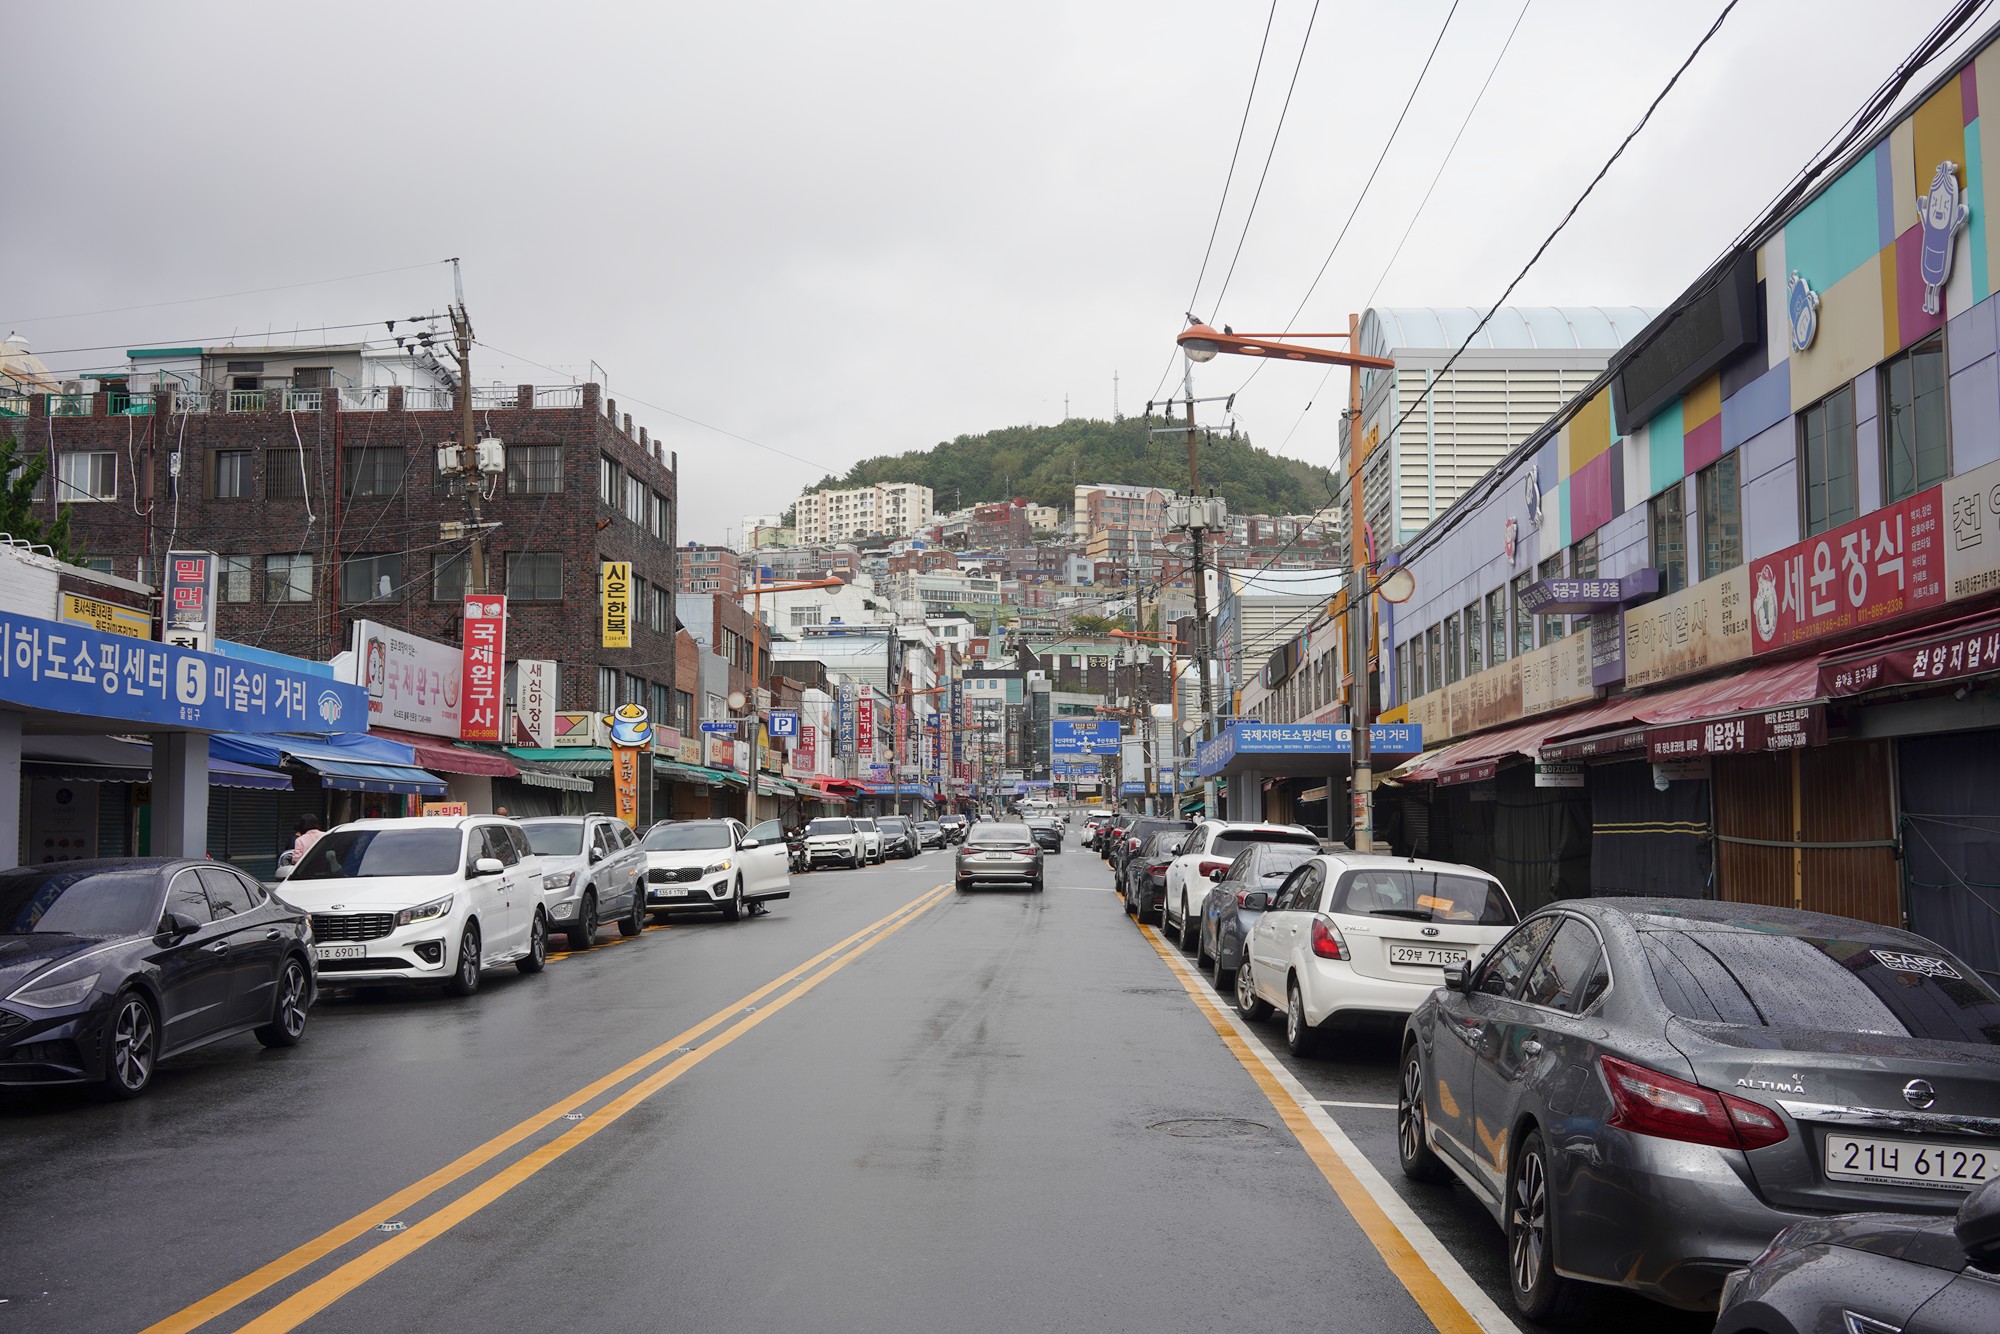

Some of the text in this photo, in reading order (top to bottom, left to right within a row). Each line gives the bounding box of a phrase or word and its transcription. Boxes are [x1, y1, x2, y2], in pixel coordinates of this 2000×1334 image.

[1781, 513, 1905, 624] 세운장식
[173, 559, 206, 611] 밀면
[1552, 581, 1620, 598] 5공구 B동 2층
[606, 564, 628, 635] 시온한복
[74, 598, 113, 621] 동서식품대리점
[1626, 598, 1708, 660] 동아지업사
[1089, 656, 1108, 668] 동광
[1912, 632, 2000, 678] 천양지업사
[388, 659, 441, 707] 국제완구
[468, 623, 497, 728] 국제완구사
[1835, 671, 1853, 688] 유아용
[185, 663, 198, 699] 5
[214, 665, 267, 716] 미술의
[274, 677, 307, 721] 거리
[527, 663, 543, 736] 새신아장식
[179, 705, 202, 722] 출입구
[461, 728, 498, 738] T.245-9999
[778, 719, 789, 731] P
[1241, 729, 1332, 742] 국제지하도쇼핑센터
[1340, 730, 1348, 740] 6
[1388, 729, 1409, 742] 거리
[1703, 720, 1746, 752] 세운장식
[335, 947, 360, 958] 6901
[1398, 948, 1461, 964] 29부 7135
[1877, 952, 1943, 970] BABY
[1887, 962, 1955, 976] ON BOARD
[1734, 1077, 1806, 1095] ALTIMA
[1843, 1142, 1986, 1182] 21너 6122
[1863, 1176, 1890, 1184] NISSAN.
[1890, 1178, 1926, 1187] Innovation
